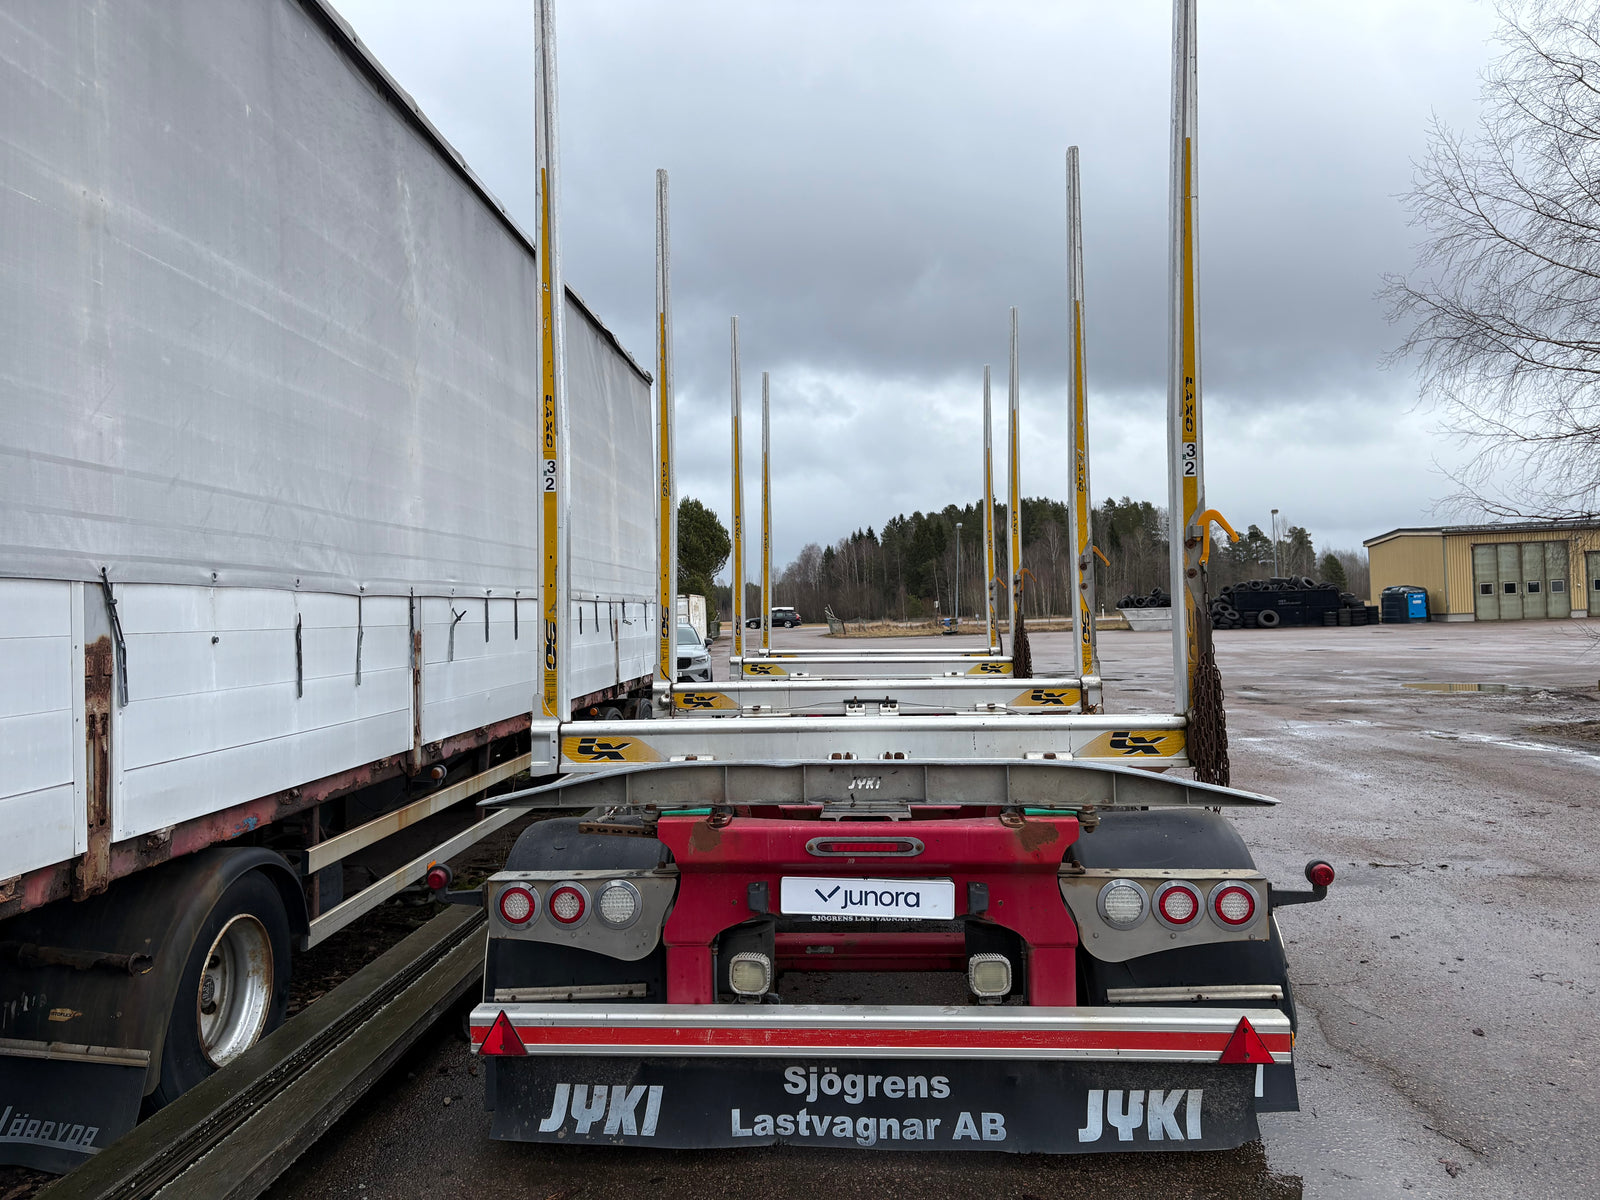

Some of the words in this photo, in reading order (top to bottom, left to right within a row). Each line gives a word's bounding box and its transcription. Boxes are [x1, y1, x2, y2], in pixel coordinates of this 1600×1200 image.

[545, 394, 553, 448] LAXO
[1185, 376, 1193, 432] LAXO
[841, 889, 920, 910] junora
[538, 1083, 664, 1137] JYKI
[783, 1066, 951, 1105] Sjögrens
[731, 1107, 942, 1146] Lastvagnar
[952, 1111, 1007, 1141] AB
[1078, 1089, 1204, 1143] JYKI
